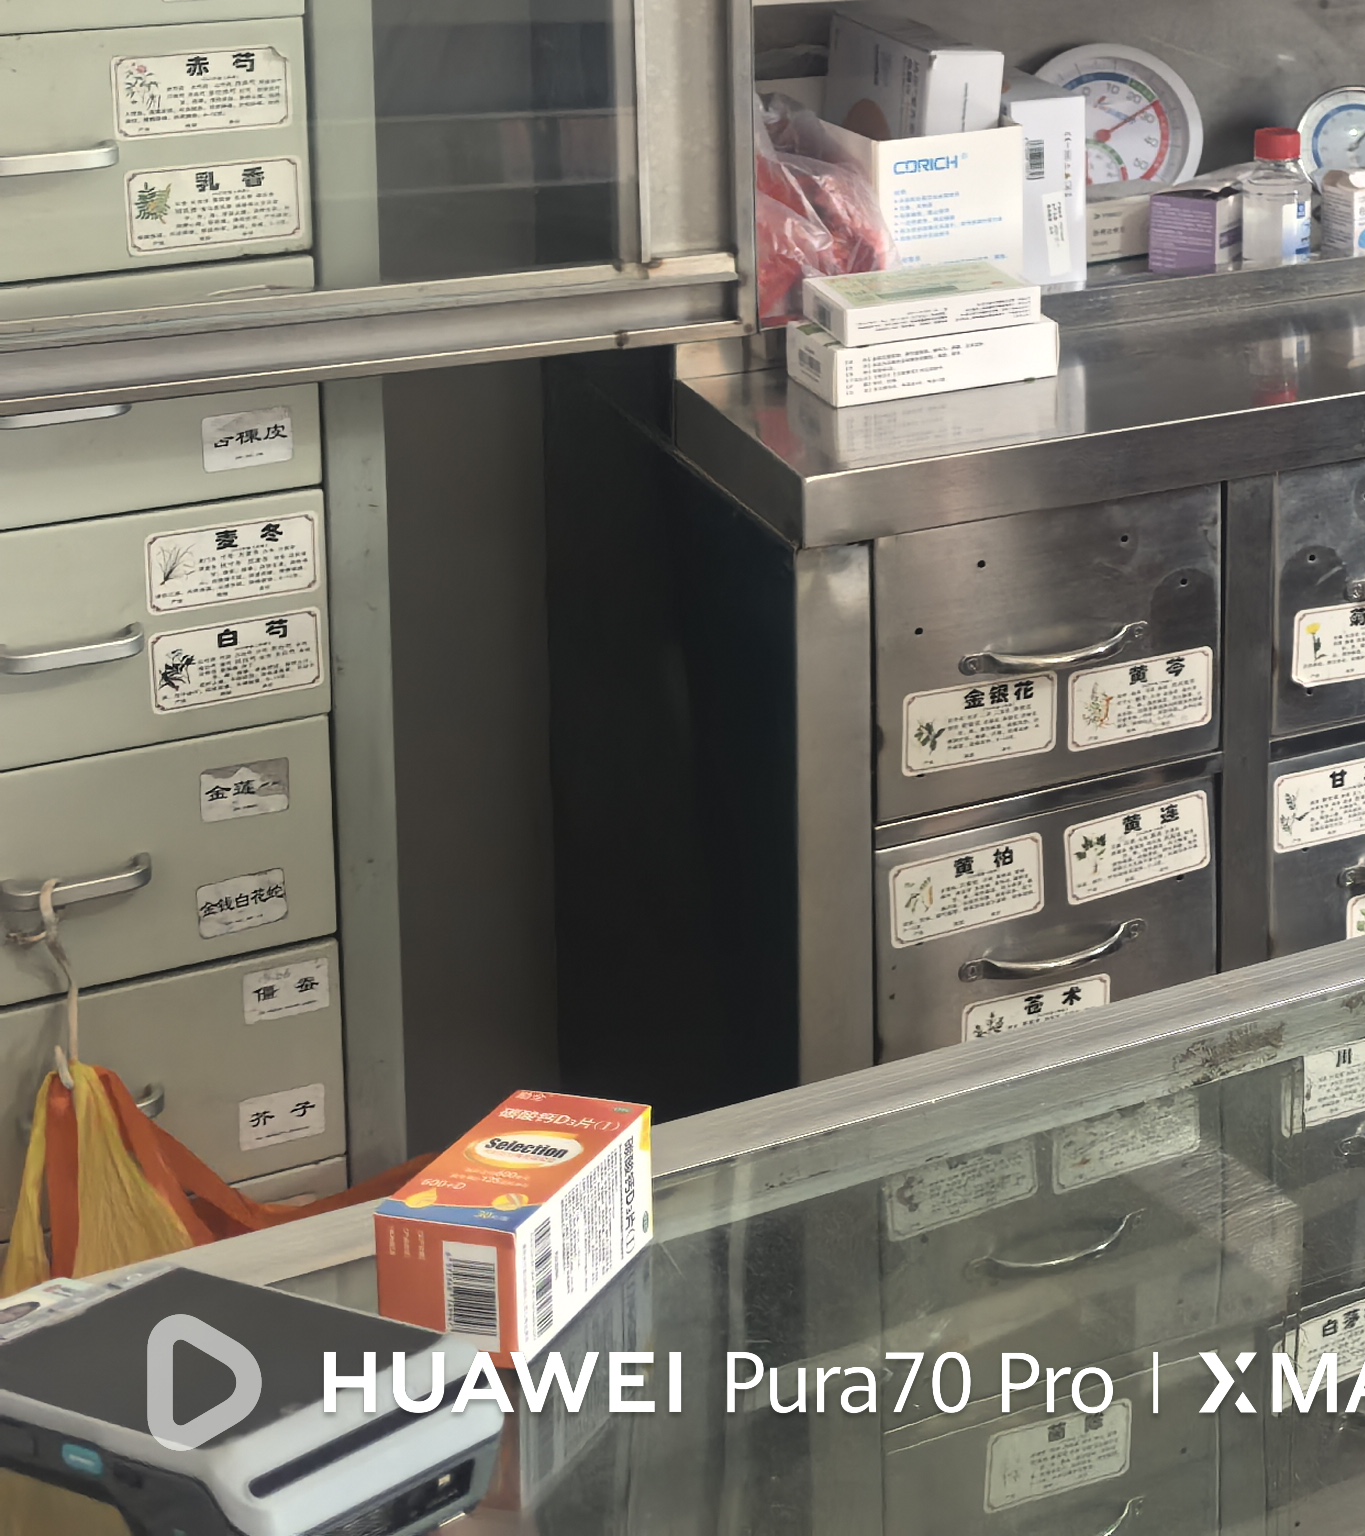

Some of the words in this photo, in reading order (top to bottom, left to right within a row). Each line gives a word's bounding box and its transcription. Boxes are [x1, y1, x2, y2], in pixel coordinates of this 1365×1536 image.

[186, 51, 256, 76] 赤芍
[1106, 81, 1121, 95] 10
[1126, 90, 1143, 104] 20
[196, 166, 265, 193] 乳香
[893, 156, 959, 175] CORICH
[215, 522, 283, 550] 麦冬
[217, 618, 288, 649] 白芍
[1129, 656, 1187, 685] 黄芩
[963, 679, 1036, 711] 金银花
[205, 779, 280, 802] 金莲
[1122, 804, 1181, 835] 黄连
[953, 846, 1015, 879] 黄柏
[200, 884, 286, 919] 金钱白花蛇
[1023, 986, 1082, 1015] 苍术
[249, 1100, 316, 1128] 芥子
[484, 1135, 569, 1161] Selection
